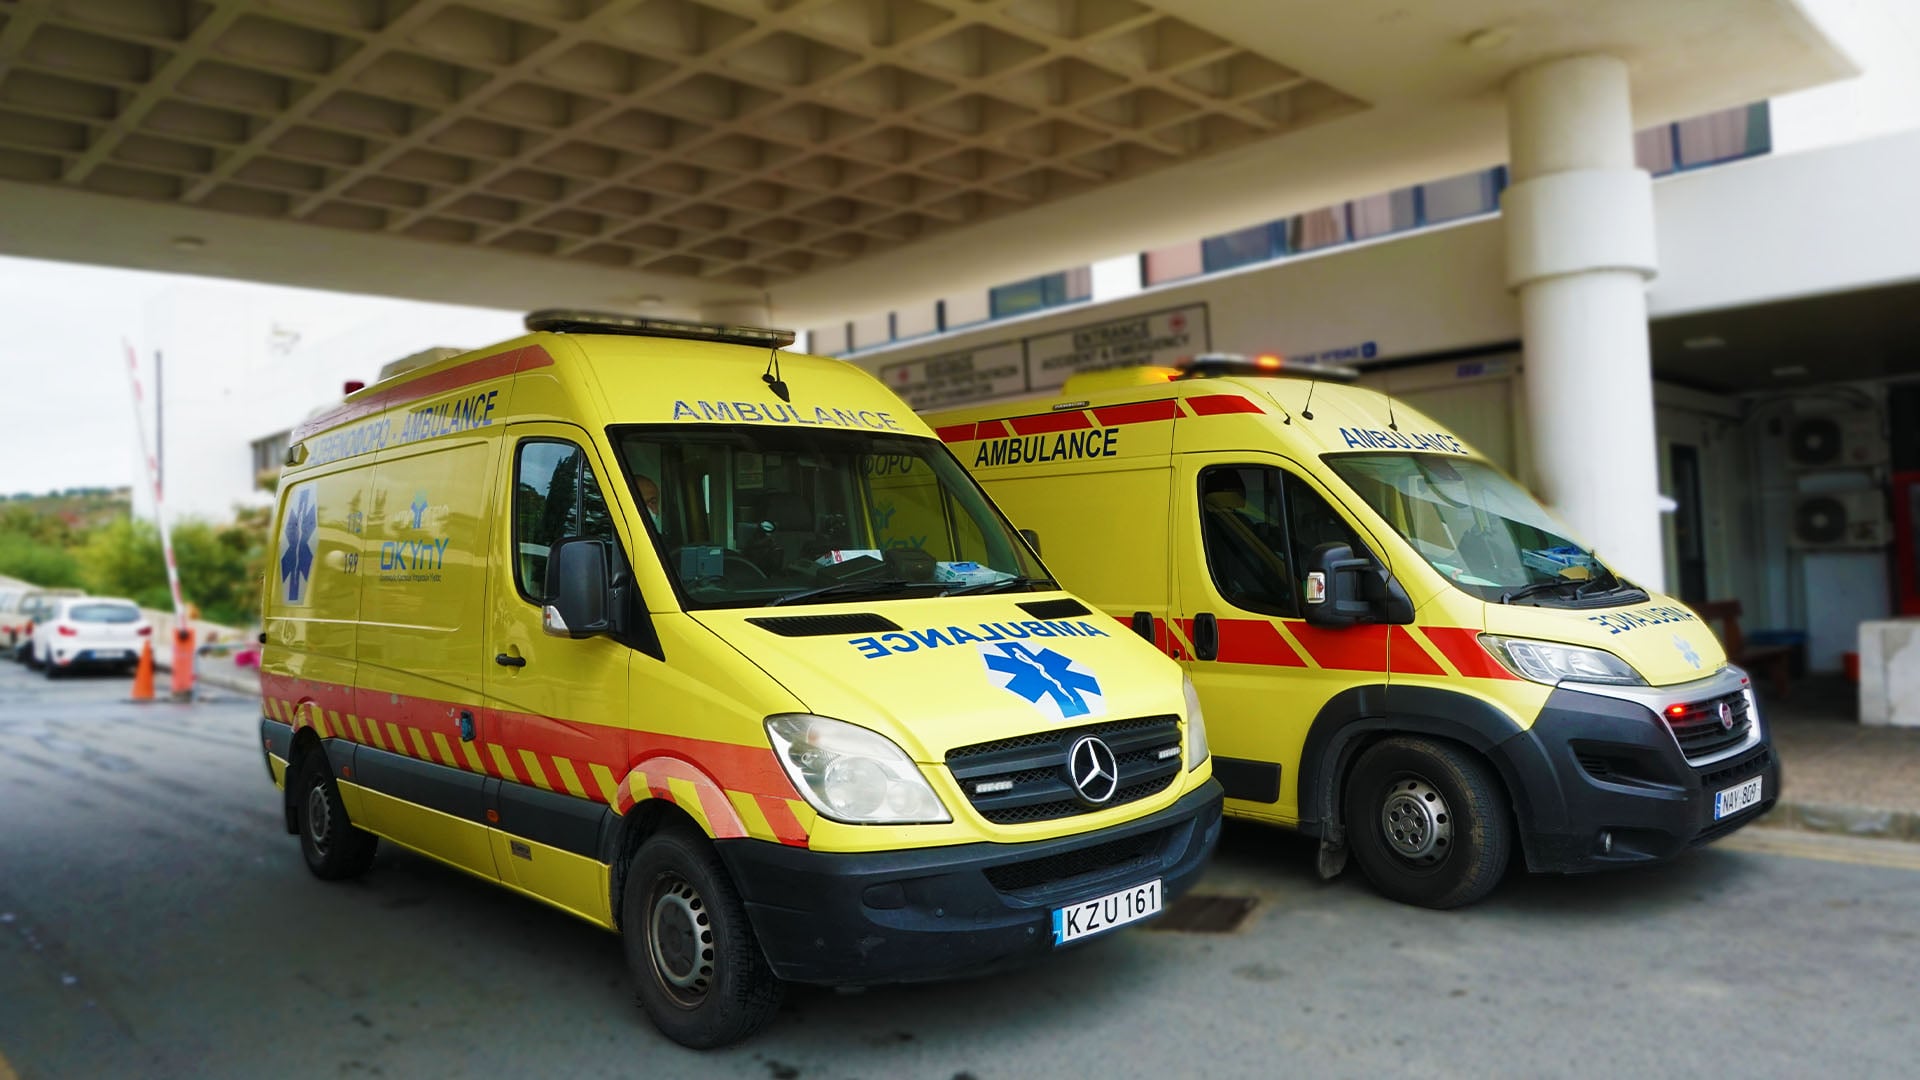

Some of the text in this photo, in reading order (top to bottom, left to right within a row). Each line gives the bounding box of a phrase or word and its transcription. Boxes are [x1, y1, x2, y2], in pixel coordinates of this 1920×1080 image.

[1074, 318, 1149, 349] ENTRANCE
[400, 390, 498, 442] AMBULANCE
[673, 400, 904, 431] AMBULANCE
[974, 428, 1120, 468] AMBULANCE
[1339, 427, 1468, 455] AMBULANCE
[343, 552, 359, 575] 199
[1066, 884, 1155, 937] KZU 161
